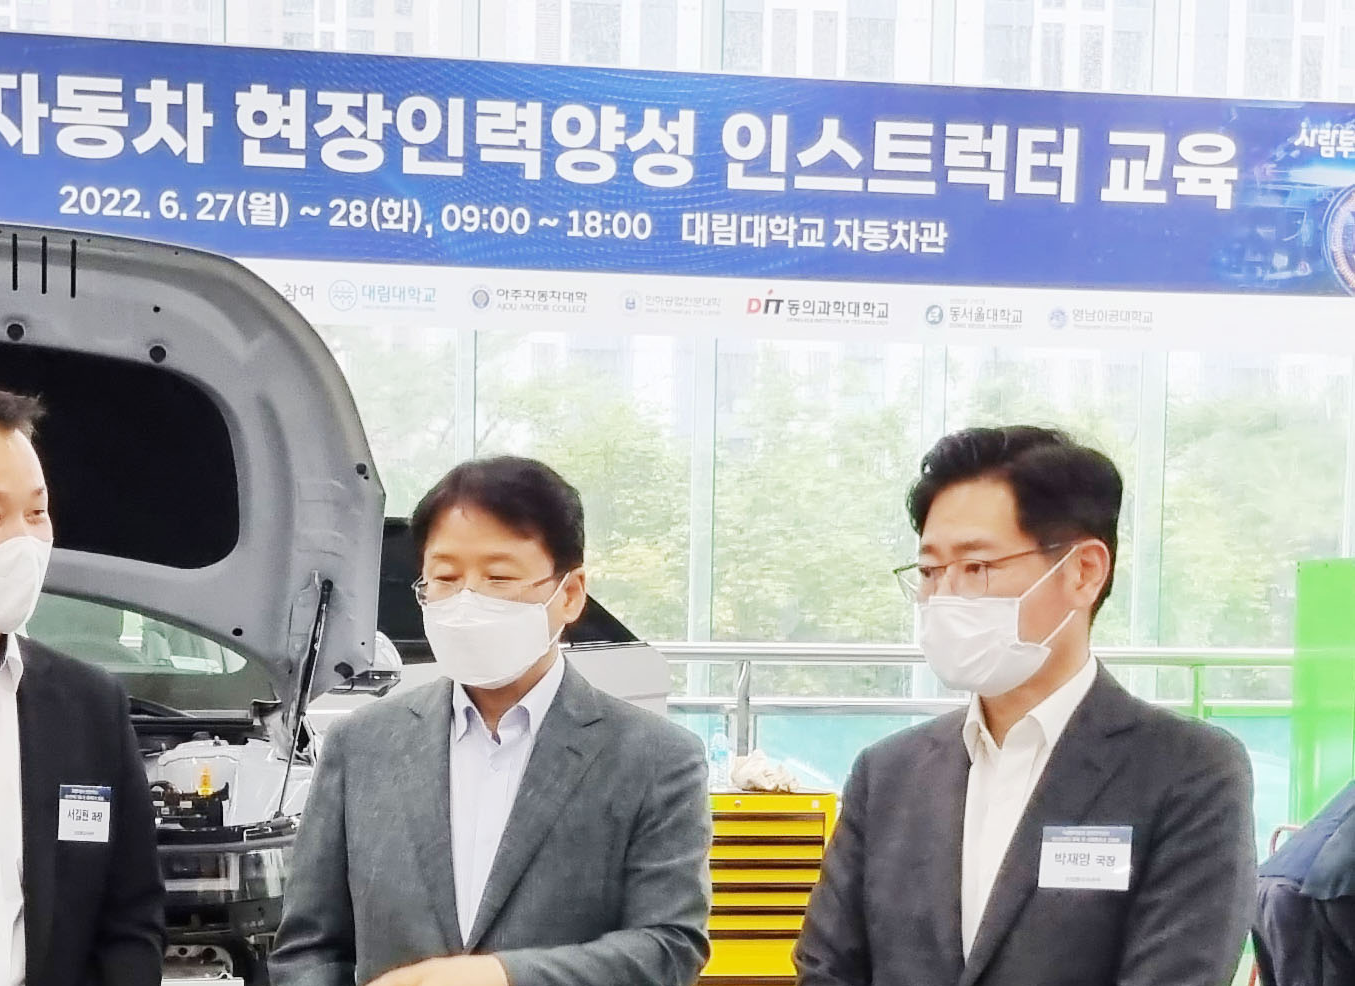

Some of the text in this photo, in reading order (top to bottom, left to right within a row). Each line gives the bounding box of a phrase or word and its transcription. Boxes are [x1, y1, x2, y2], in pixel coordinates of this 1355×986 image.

[235, 84, 696, 189] 현장인력양성
[721, 112, 1080, 204] 인스트럭터
[1100, 130, 1239, 210] 교육
[59, 184, 949, 254] 2022. 6. 27(월) ~ 28(화), 09:00 ~ 18:00 대림대학교 자동차관
[361, 284, 436, 304] 대림대학교
[787, 299, 889, 319] 동의과학대학교
[949, 306, 1023, 324] 동서울대학교
